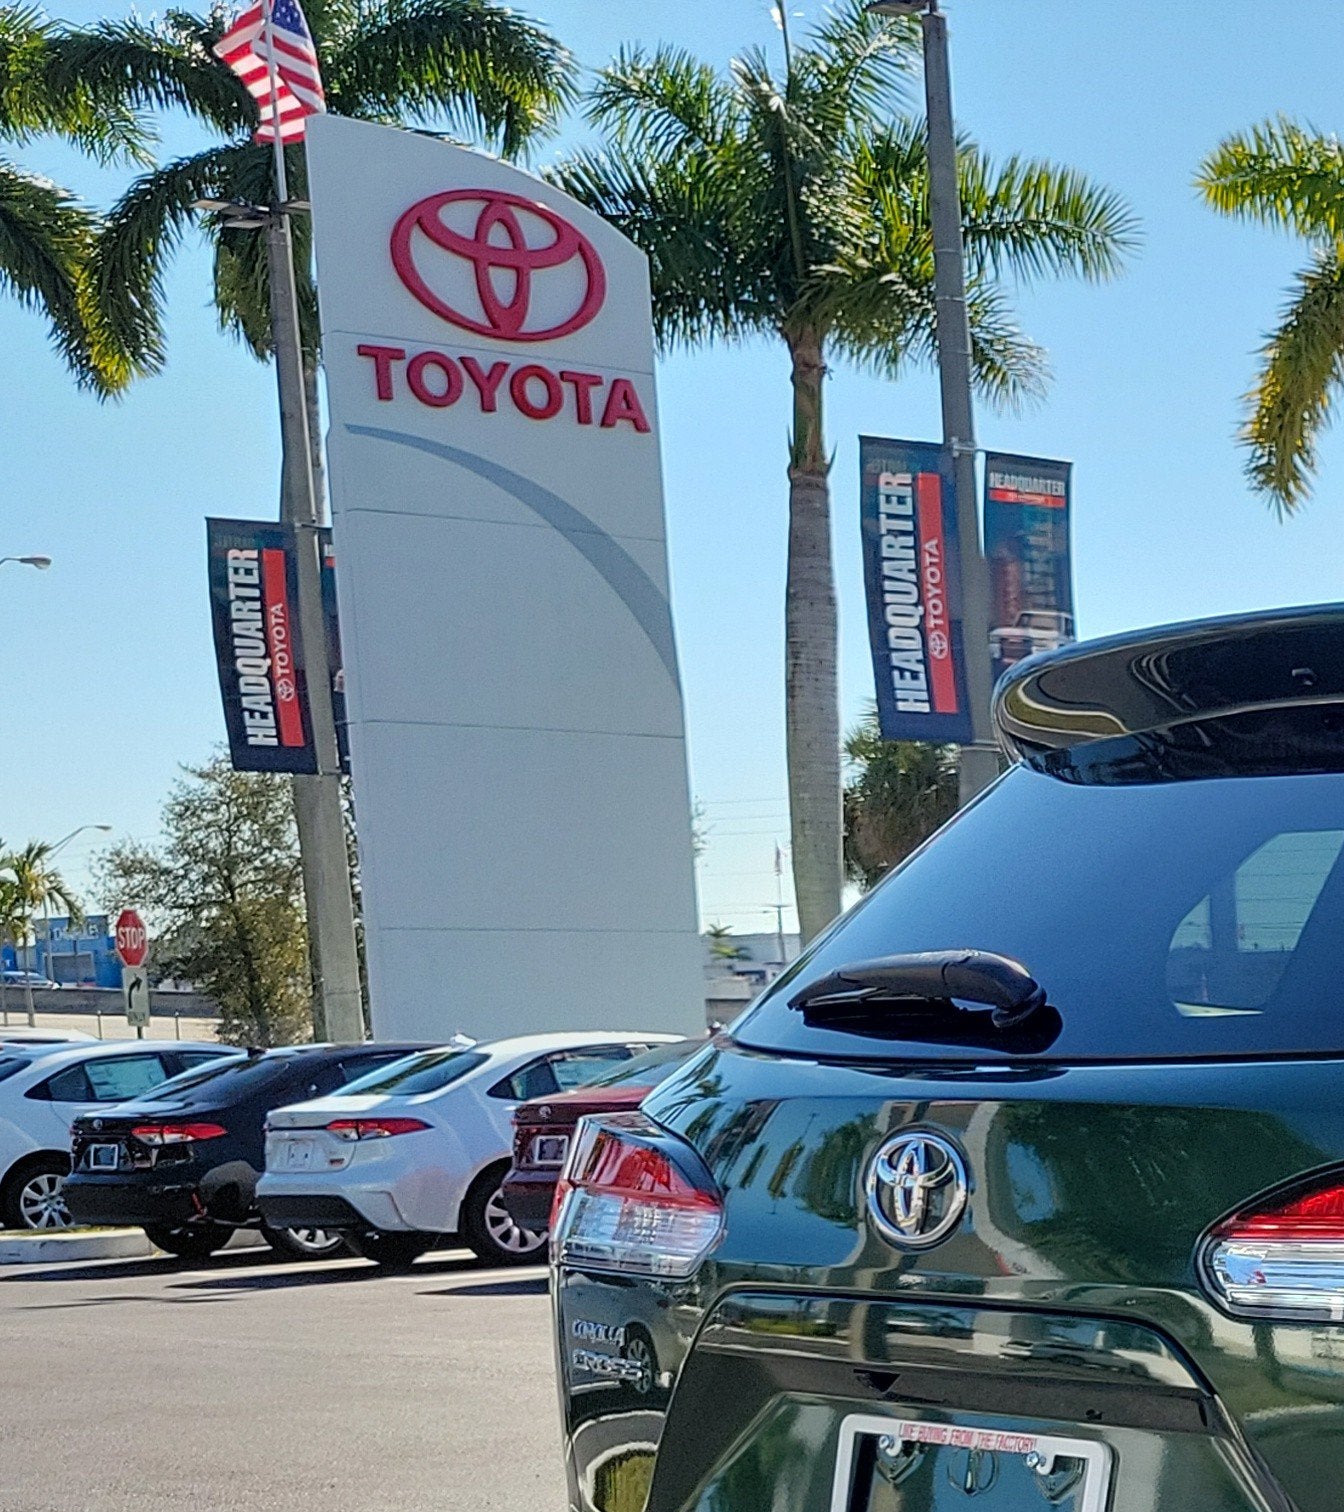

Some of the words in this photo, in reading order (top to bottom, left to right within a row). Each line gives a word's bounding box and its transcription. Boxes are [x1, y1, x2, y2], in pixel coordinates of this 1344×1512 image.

[357, 343, 652, 433] TOYOTA
[877, 471, 931, 714] HEADQUARTER
[922, 538, 944, 629] TOYOTA
[227, 548, 279, 746] HEADQUARTER
[270, 602, 291, 677] TOYOTA
[118, 927, 146, 950] STOP
[572, 1319, 626, 1348] COROLLA
[573, 1348, 642, 1381] CROSS
